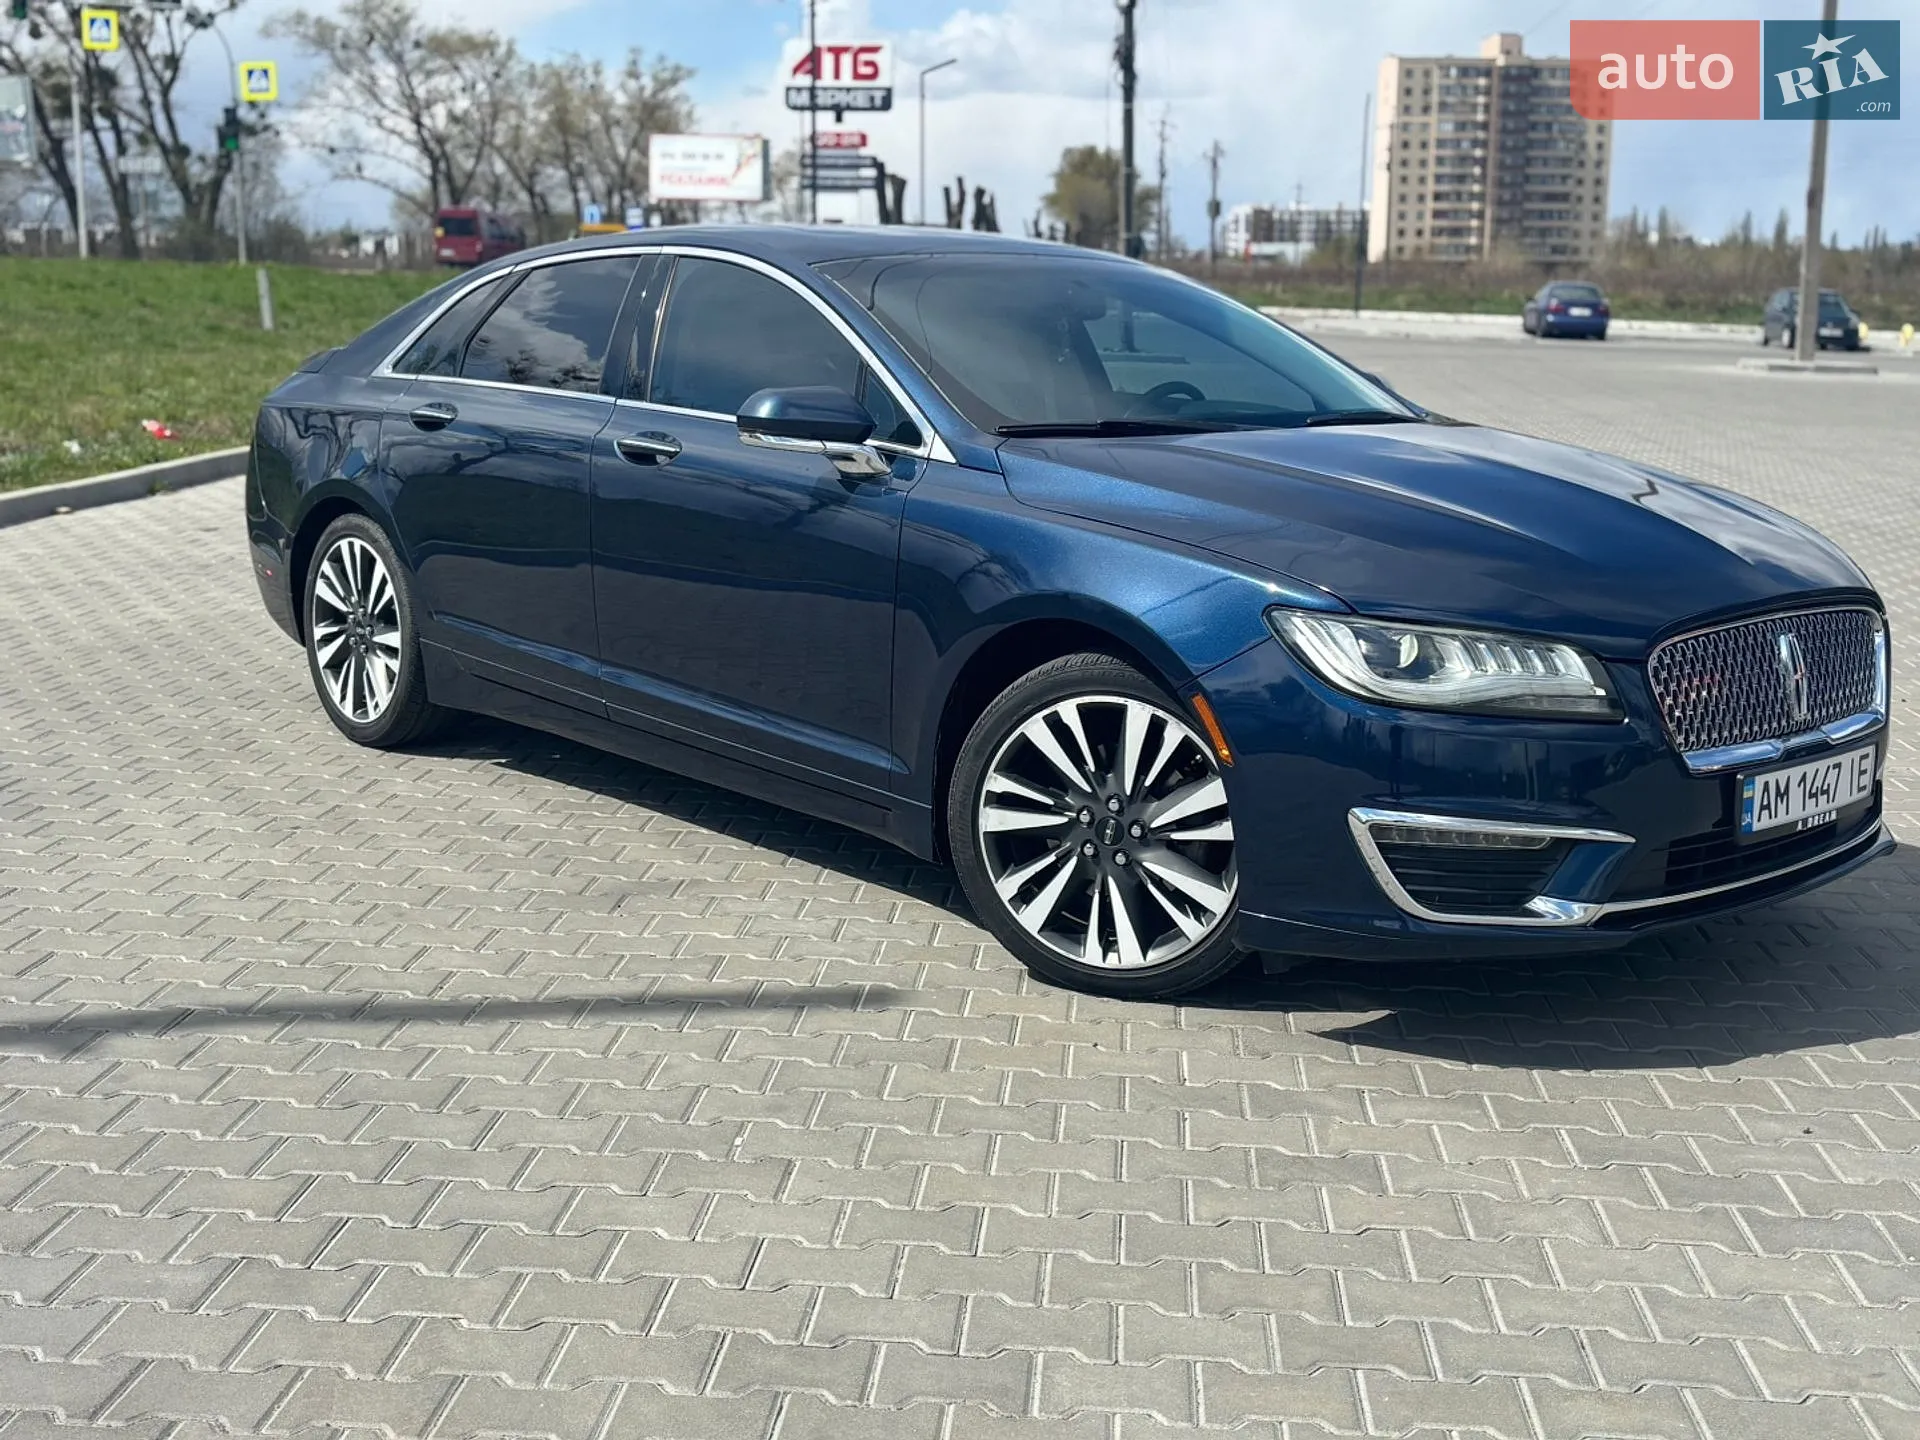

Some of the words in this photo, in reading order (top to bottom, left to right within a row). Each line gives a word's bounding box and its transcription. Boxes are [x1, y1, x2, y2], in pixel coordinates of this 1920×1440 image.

[792, 45, 883, 80] АТБ
[1757, 775, 1791, 822] AM
[1797, 762, 1842, 812] 1447
[1849, 752, 1870, 798] IE
